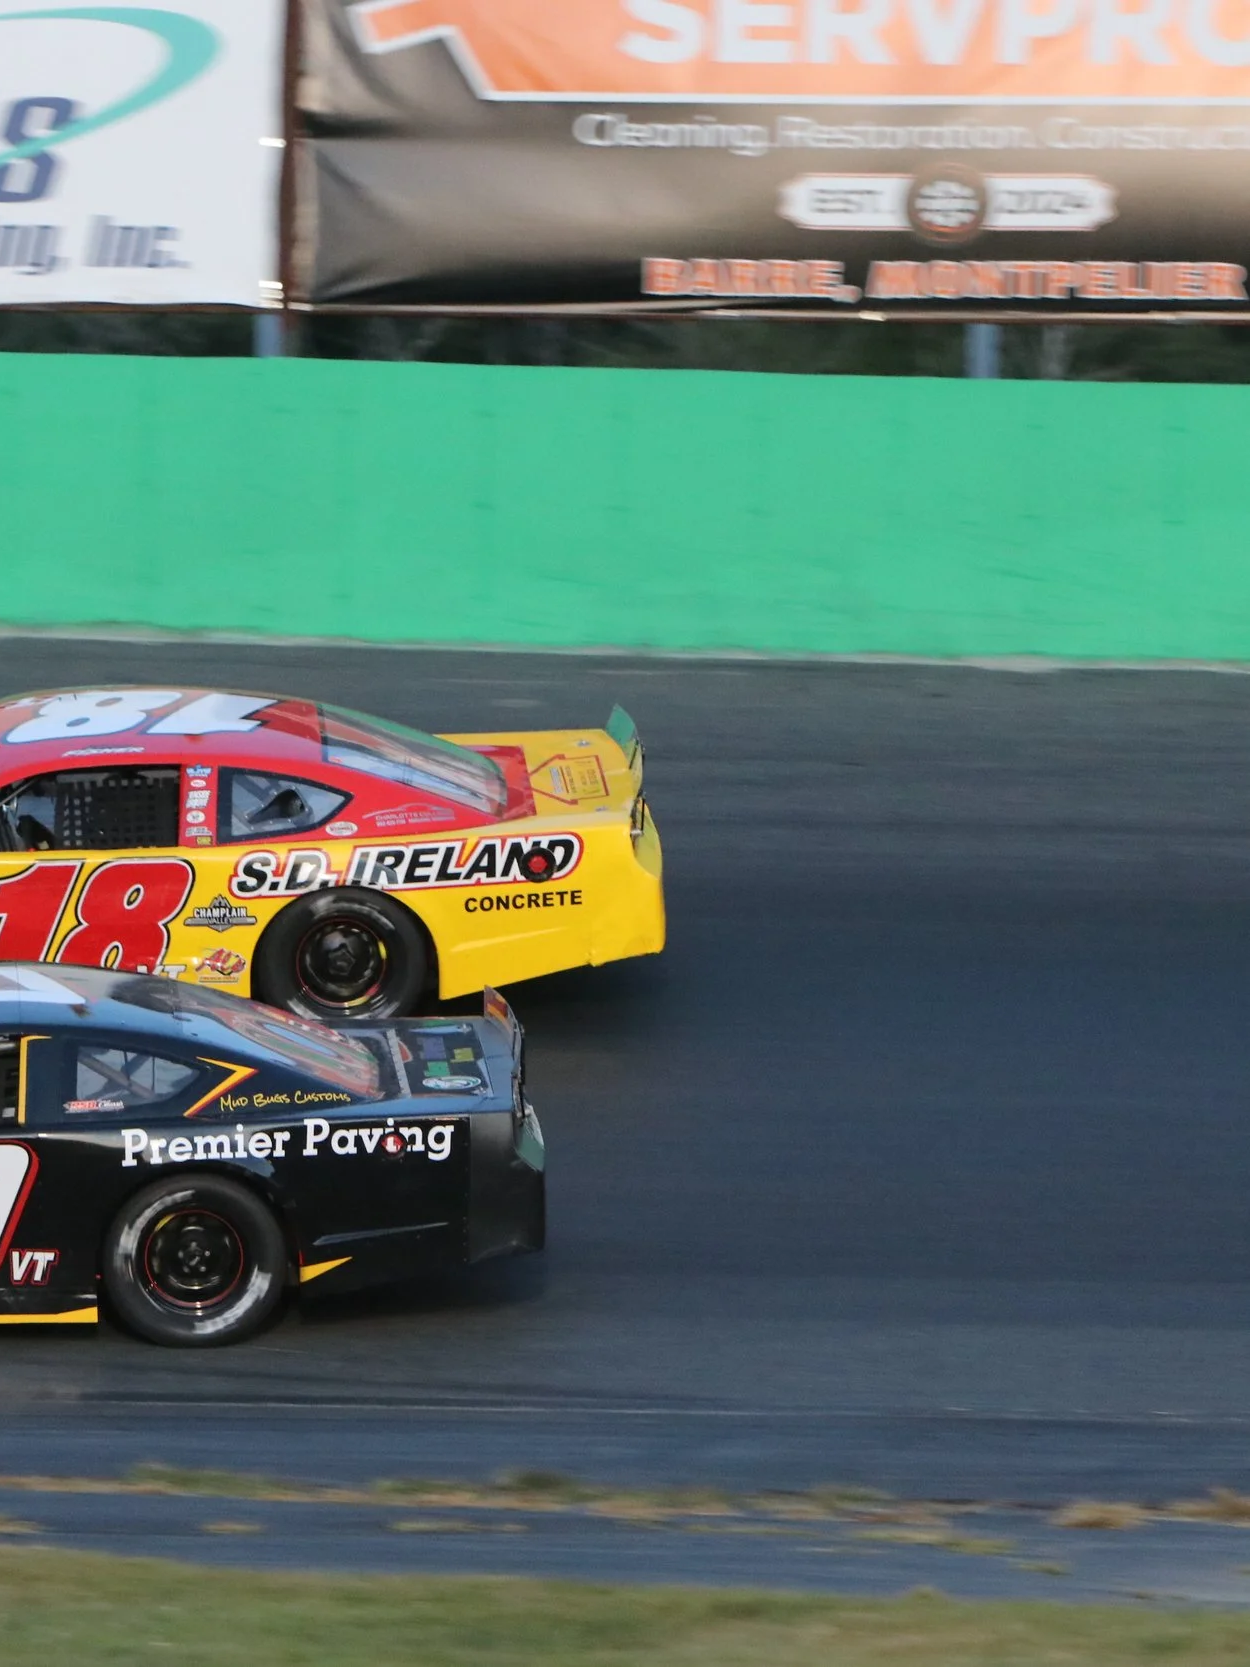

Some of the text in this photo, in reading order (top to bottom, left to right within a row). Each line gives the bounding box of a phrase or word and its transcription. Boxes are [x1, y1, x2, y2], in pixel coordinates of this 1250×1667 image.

[84, 214, 190, 269] Inc.
[640, 257, 1248, 303] BARRE, MONTPELIER
[236, 838, 577, 892] S.D. IRELAND
[194, 907, 248, 918] CHAMPLAIN
[464, 890, 583, 913] CONCRETE
[121, 1117, 455, 1167] Premier Paving
[10, 1250, 57, 1284] VT
